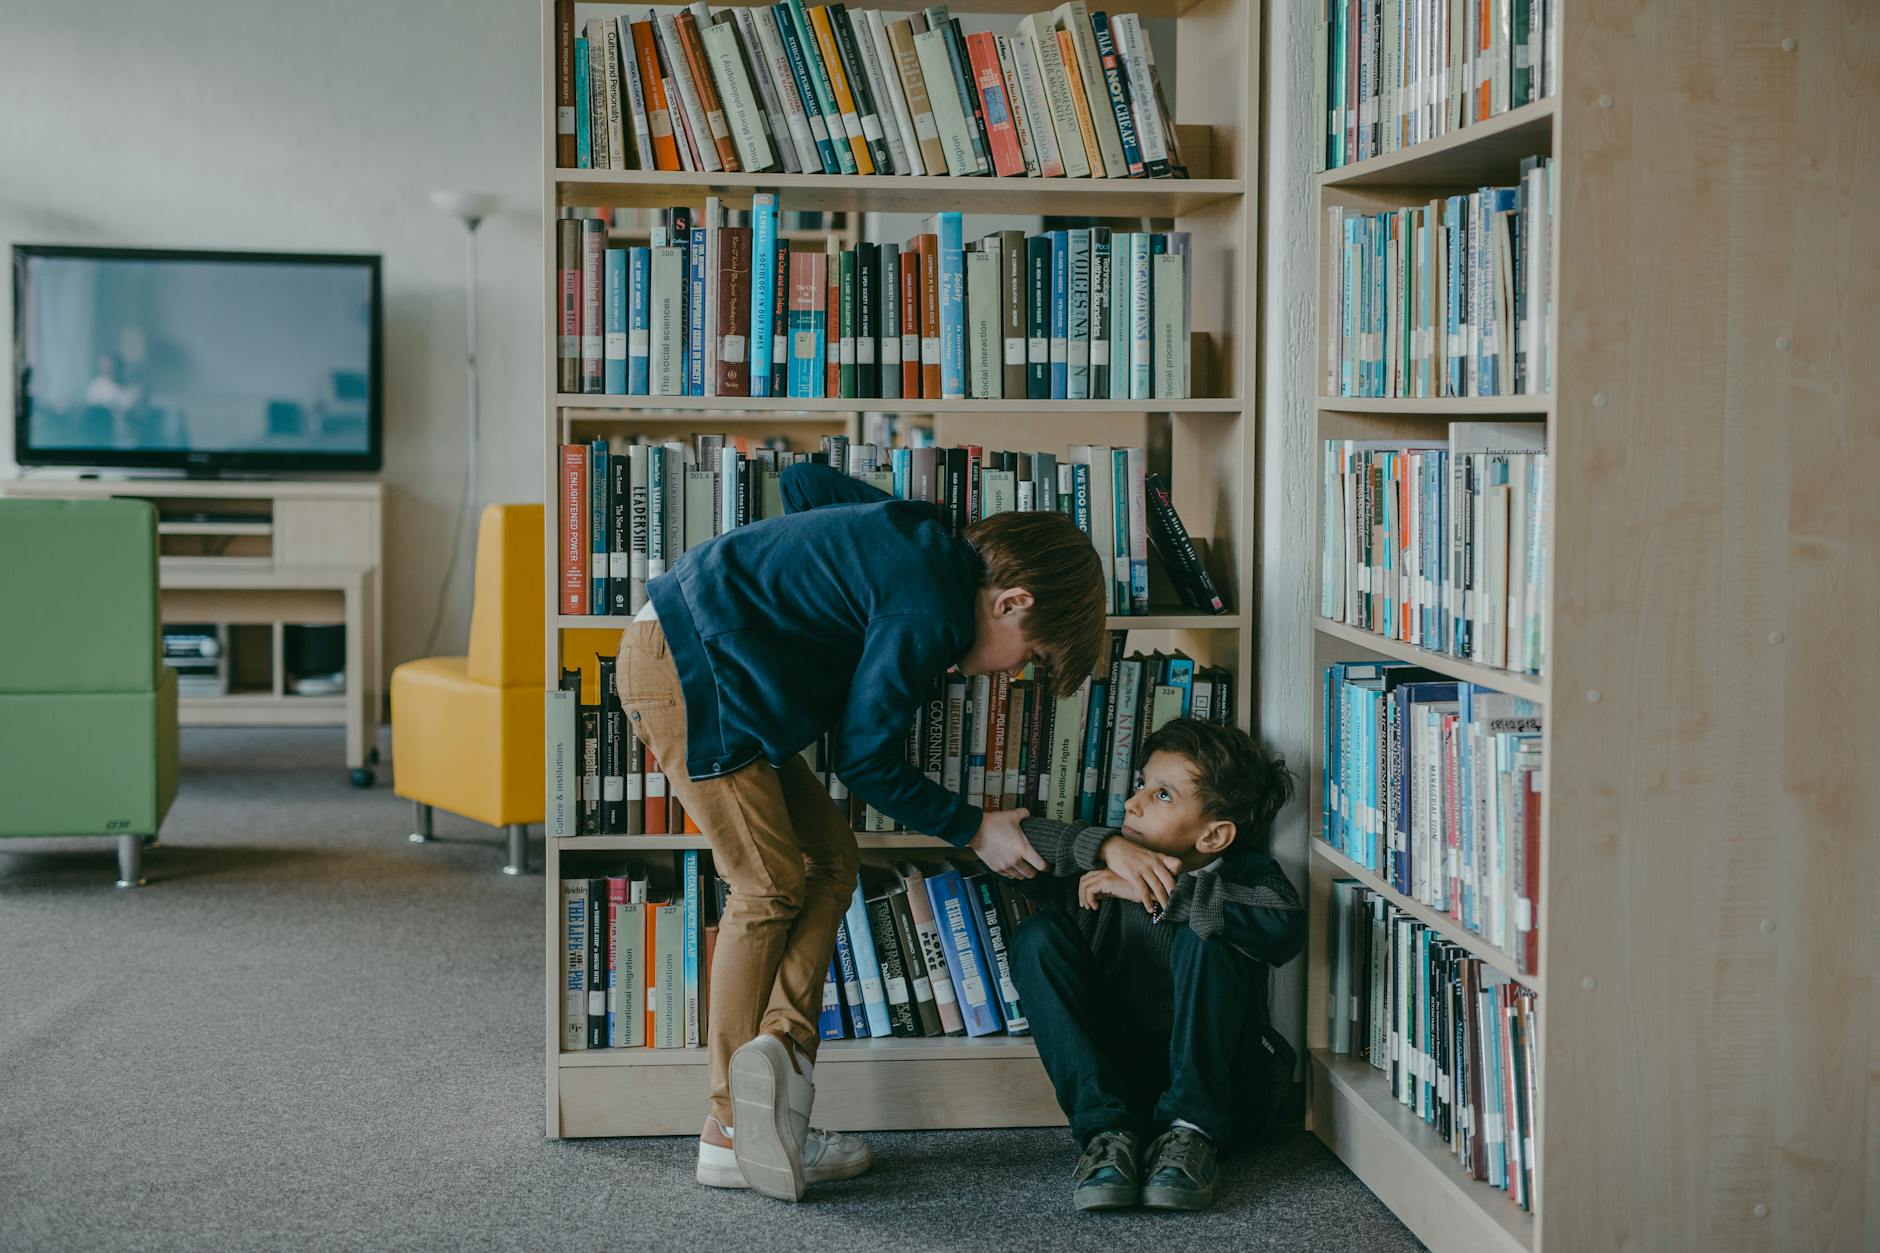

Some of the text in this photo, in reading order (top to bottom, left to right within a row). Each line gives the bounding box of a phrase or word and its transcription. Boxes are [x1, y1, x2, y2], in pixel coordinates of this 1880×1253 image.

[742, 13, 750, 25] The
[608, 32, 616, 61] Culture
[609, 63, 617, 78] and
[789, 36, 812, 100] ETHICS FOR PUBLIC
[1006, 70, 1015, 82] The
[1040, 40, 1065, 122] ALISTER MCGRATH
[1045, 25, 1076, 134] NIV BIBLE COMMENTARY
[610, 79, 620, 123] Personality
[632, 80, 641, 108] ILLUSIONS
[1008, 83, 1020, 105] Battle
[1097, 29, 1136, 148] TALK NOT CHEAP!
[720, 60, 761, 170] Ethics Moral philosophy
[1020, 63, 1050, 162] THE GOD DELUSION
[952, 135, 969, 175] Religion
[778, 248, 786, 260] The
[566, 272, 575, 293] FIRE
[943, 273, 951, 306] in Focus
[954, 272, 962, 302] Society
[1074, 249, 1089, 309] VOICES
[1094, 256, 1102, 337] without Boundaries
[1102, 256, 1110, 307] Technologies
[1135, 252, 1148, 340] ORGANIZATIONS
[758, 299, 765, 307] IN
[775, 298, 784, 315] Many
[663, 344, 671, 370] social
[980, 320, 988, 367] interaction
[1165, 323, 1174, 397] Social processes
[661, 380, 671, 394] The
[693, 360, 702, 384] SOCIETY
[670, 472, 678, 516] LEADERSHIP
[1077, 468, 1087, 507] WE TOO
[633, 487, 646, 554] LEADERSHIP
[1170, 519, 1196, 561] black white
[995, 672, 1008, 746] WOMEN POLITICS
[1161, 687, 1176, 695] 324
[929, 700, 943, 772] GOVERNING
[948, 698, 961, 758] LIBERTARIANISM
[1029, 756, 1037, 790] POLITICS
[1058, 738, 1070, 799] political rights
[554, 742, 564, 835] Culture institutions
[687, 856, 695, 875] THE
[687, 876, 695, 899] GAIA
[568, 898, 585, 951] THE LIFE
[687, 900, 695, 928] PEACE
[880, 902, 896, 949] FRANKLIN
[985, 908, 1005, 951] The Great
[576, 955, 584, 964] OF
[921, 932, 936, 971] PEACE
[931, 933, 945, 968] LONG
[953, 932, 971, 950] AND
[569, 952, 577, 970] THE
[624, 992, 632, 1045] International
[665, 992, 673, 1046] International
[903, 1011, 914, 1031] AND
